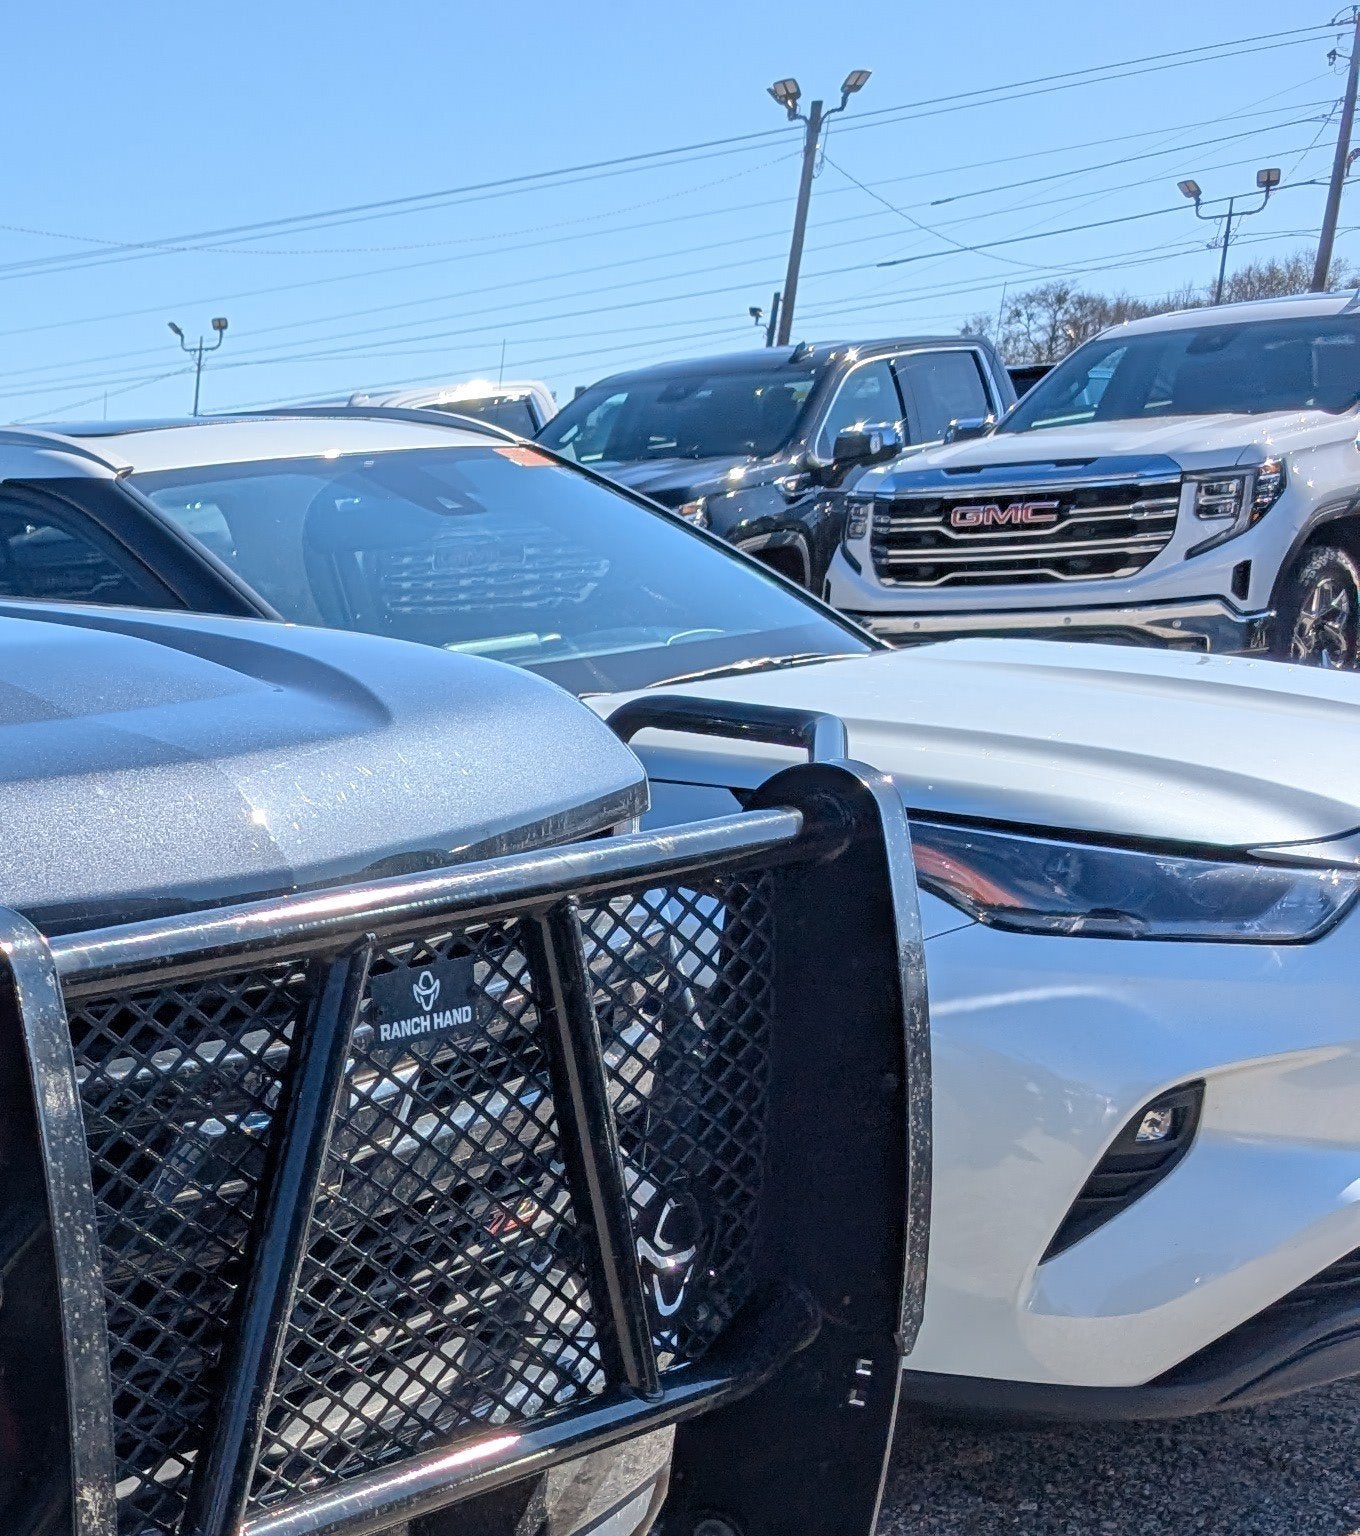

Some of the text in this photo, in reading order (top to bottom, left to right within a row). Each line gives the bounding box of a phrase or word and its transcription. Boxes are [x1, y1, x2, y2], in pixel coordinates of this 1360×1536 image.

[950, 501, 1059, 527] GMC
[380, 1006, 472, 1041] RANCH HAND
